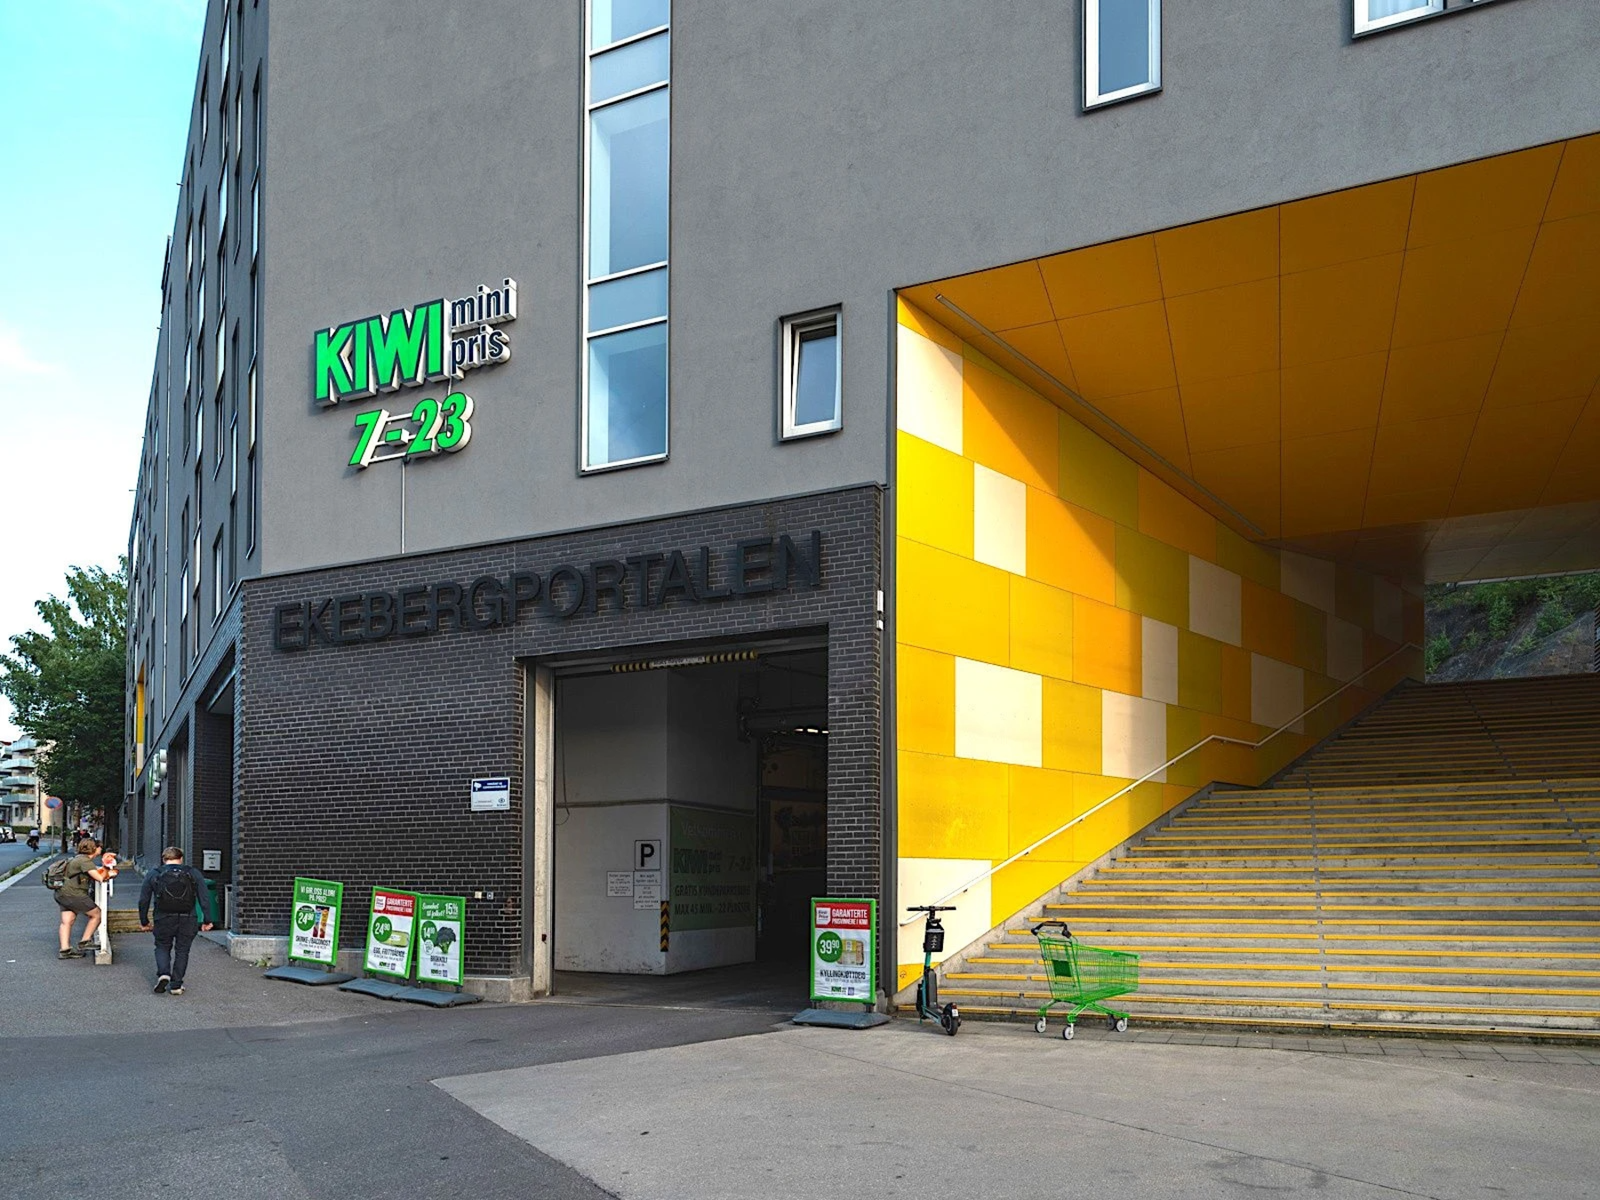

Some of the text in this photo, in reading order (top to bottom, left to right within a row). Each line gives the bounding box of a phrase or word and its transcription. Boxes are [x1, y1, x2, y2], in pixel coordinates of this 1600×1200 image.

[451, 279, 513, 329] mini
[314, 298, 447, 402] KIWI
[451, 325, 507, 376] pris
[274, 530, 821, 651] EKEBERGPORTALEN
[641, 843, 655, 867] P
[675, 884, 697, 897] GRATIS
[832, 909, 867, 918] GARANTERTE
